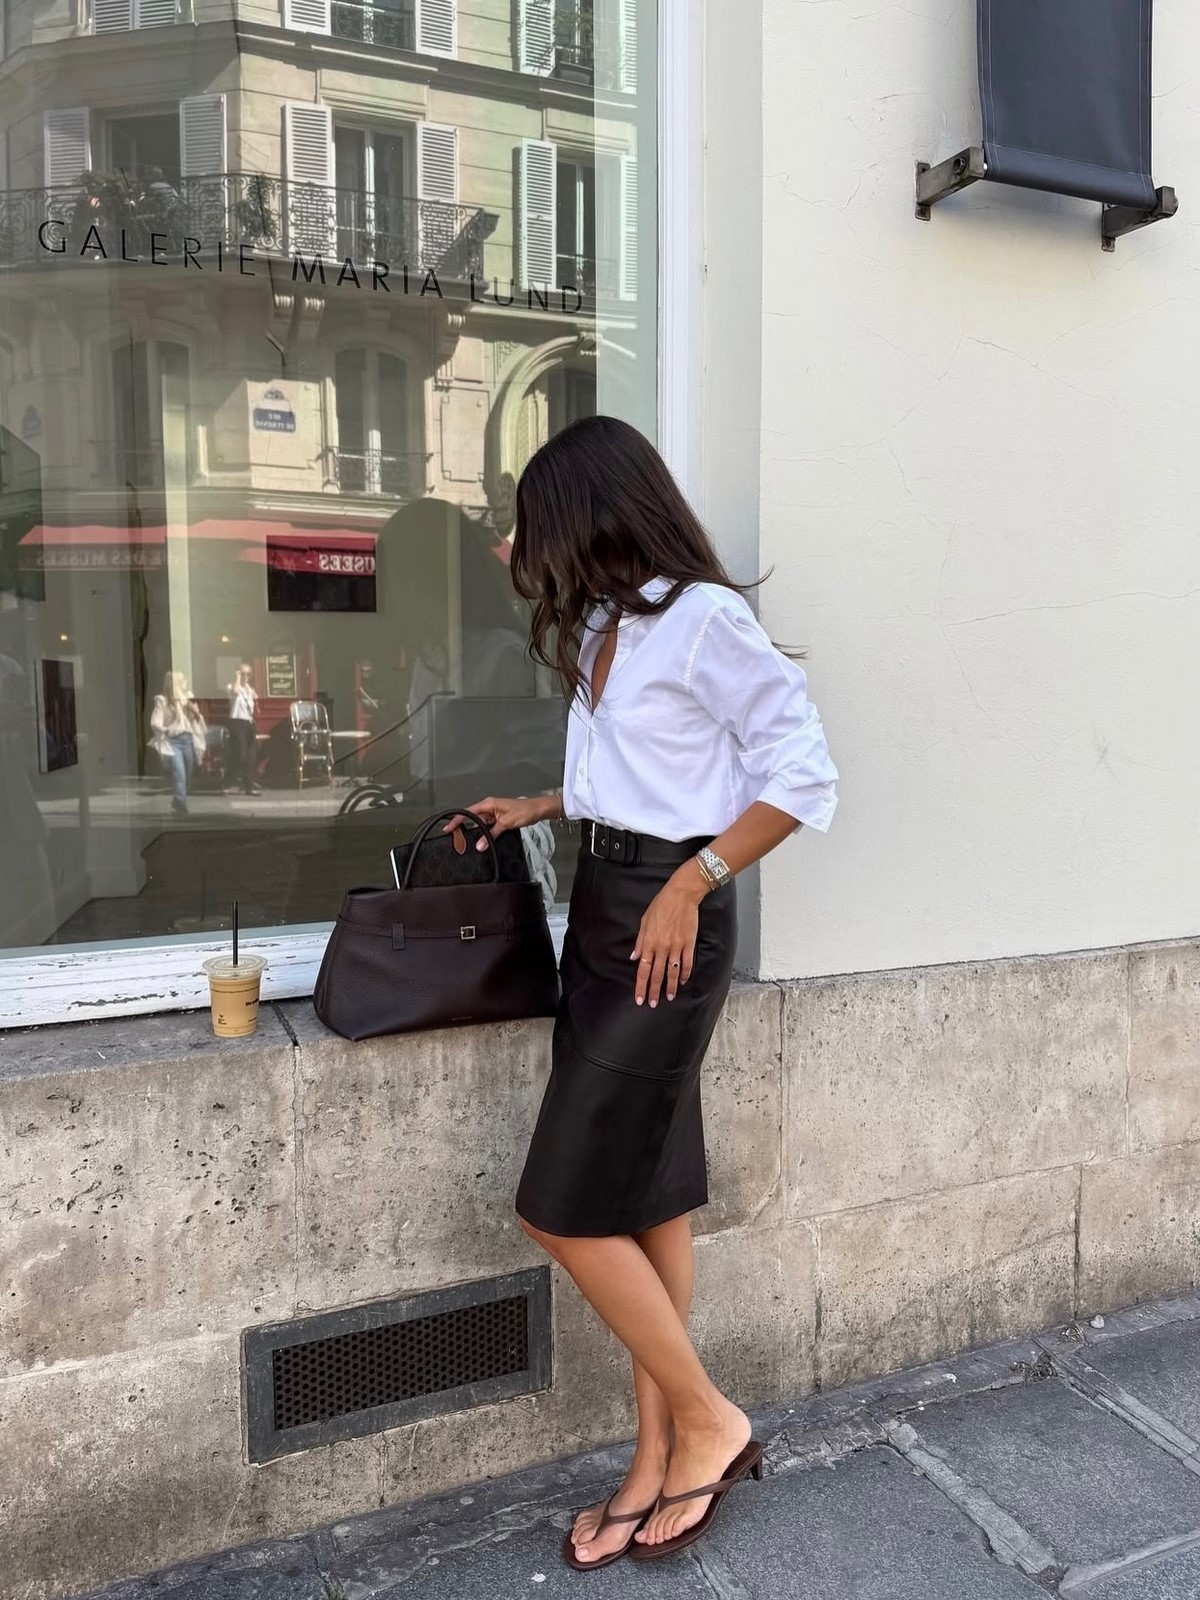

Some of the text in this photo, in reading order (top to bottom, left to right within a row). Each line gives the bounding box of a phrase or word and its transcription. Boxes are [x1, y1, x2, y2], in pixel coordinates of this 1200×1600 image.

[38, 219, 583, 314] GALERIE MARIA LUND
